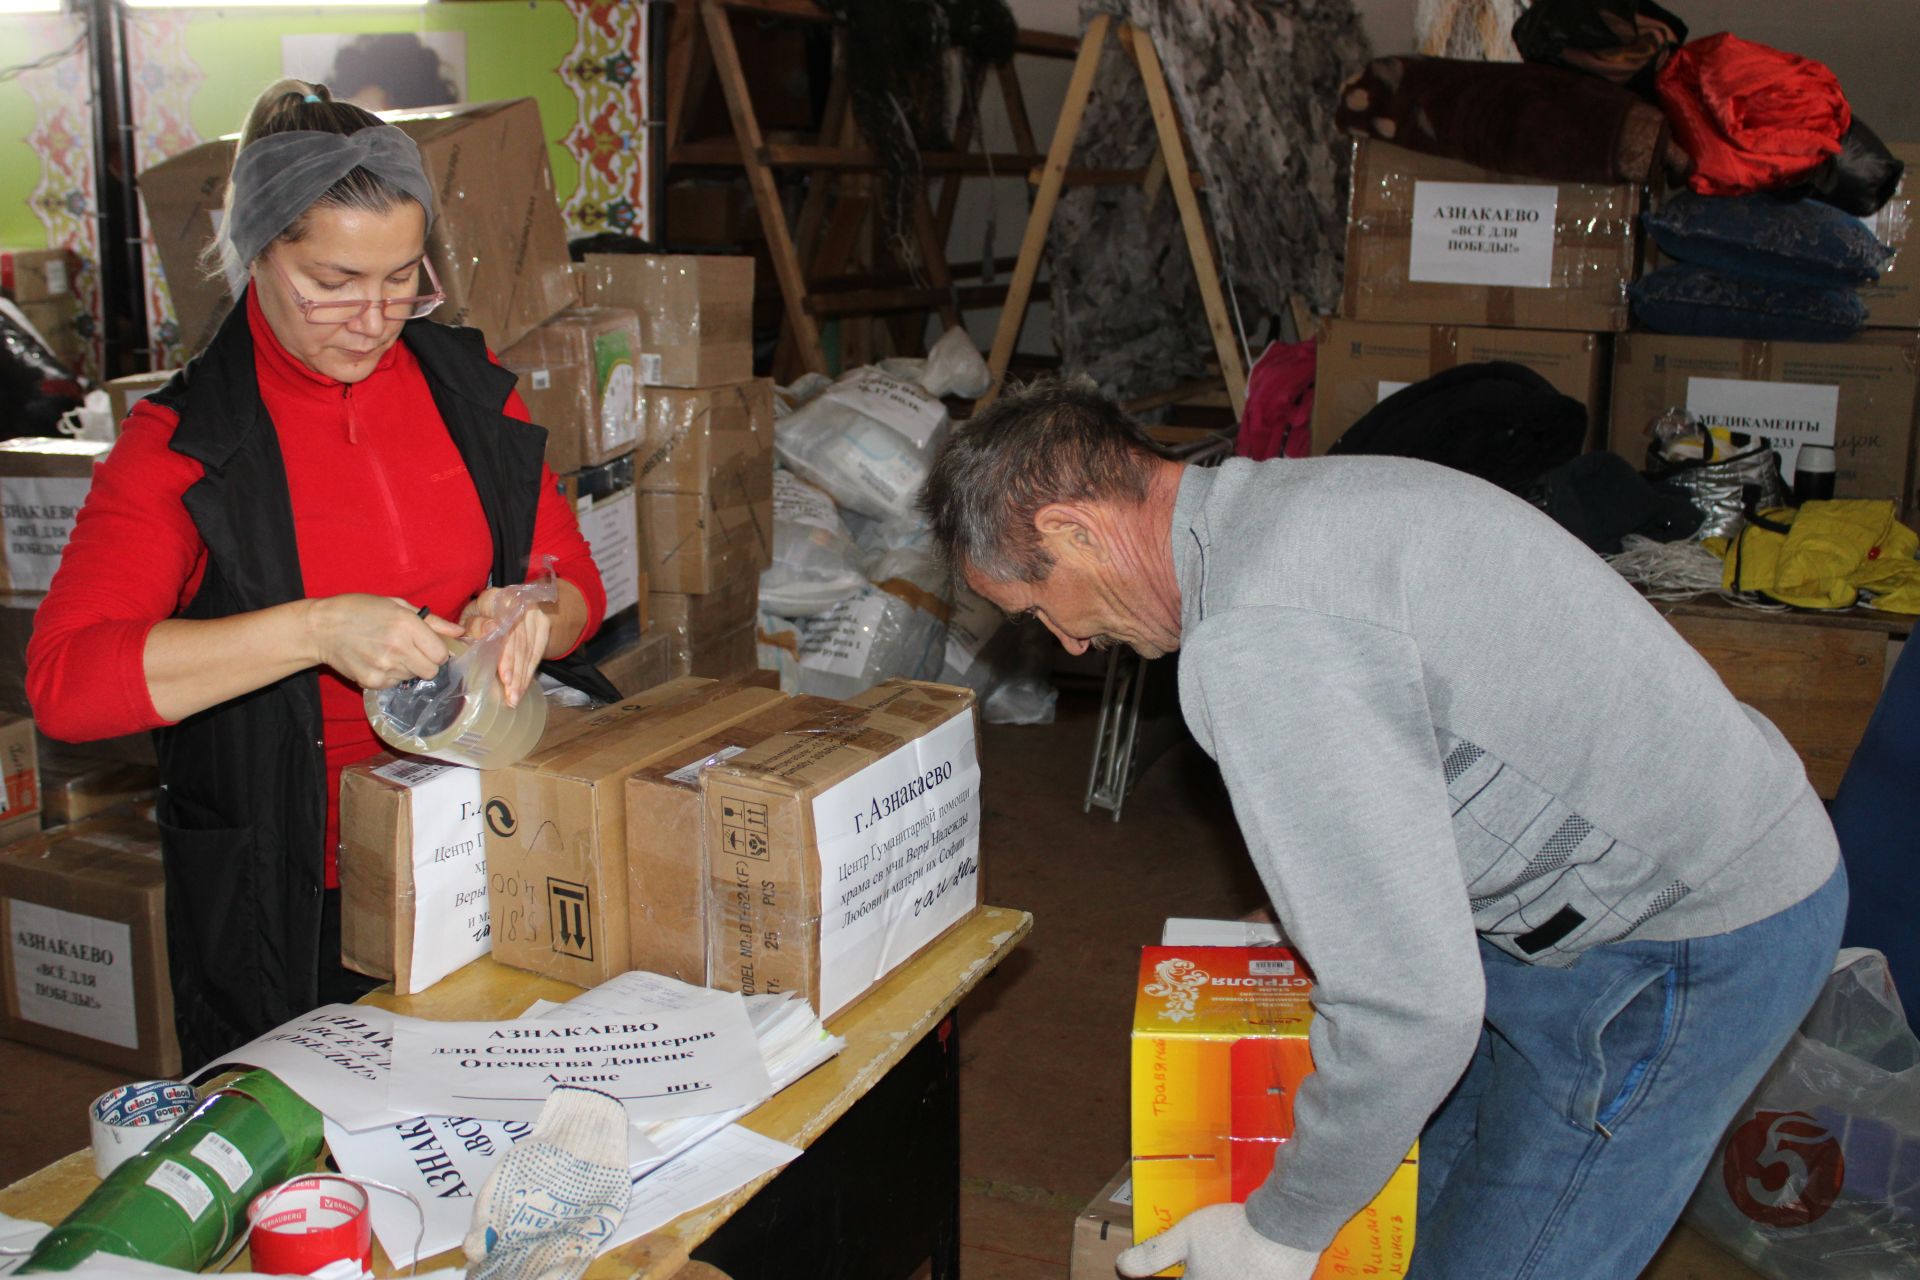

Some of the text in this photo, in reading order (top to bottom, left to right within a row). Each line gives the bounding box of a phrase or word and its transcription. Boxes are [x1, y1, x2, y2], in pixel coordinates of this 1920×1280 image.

[1434, 206, 1540, 222] АЗНАКАЕВО
[1452, 224, 1518, 239] «ВСЁ ДЛЯ
[1448, 239, 1520, 254] ПОБЕДЫ!»
[1699, 414, 1820, 433] МЕДИКАМЕНТЫ
[854, 760, 952, 835] г.Азнакаево
[838, 787, 971, 882] Центр Гуманитарной помощи
[434, 838, 475, 864] Центр
[840, 878, 871, 907] храма
[872, 869, 884, 885] св
[906, 839, 930, 864] Веры
[931, 812, 970, 847] Надежды
[841, 895, 883, 929] Любови
[892, 869, 924, 895] матери
[939, 837, 966, 865] Софии
[454, 885, 487, 908] Веры
[17, 930, 114, 966] АЗНАКАЕВО
[761, 880, 781, 996] TY: 25 PCS
[69, 970, 97, 988] ДЛЯ
[741, 962, 754, 997] ODEL
[432, 1029, 717, 1056] для Союза волонтеров
[488, 1022, 659, 1040] АЗНАКАЕВО
[460, 1050, 696, 1069] Отечества Донецк
[543, 1072, 622, 1084] Алене
[266, 1211, 302, 1227] BRAUBERG
